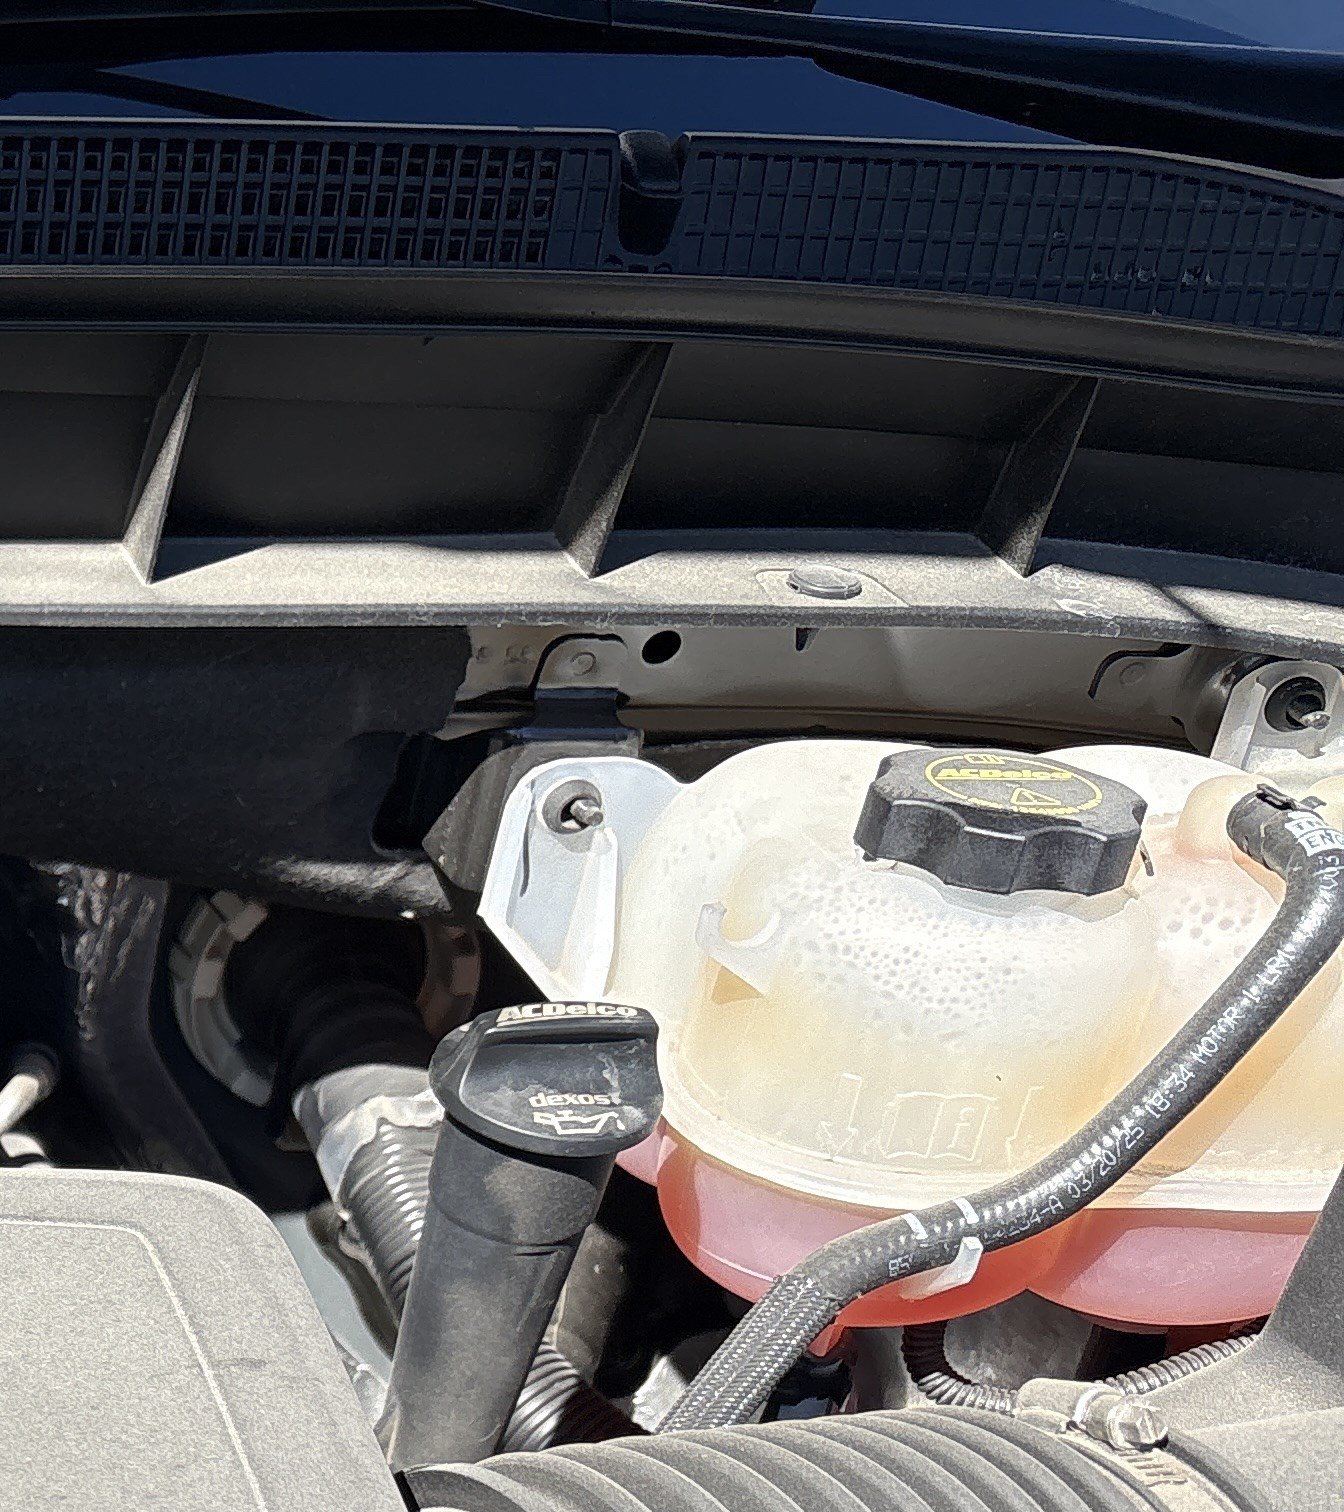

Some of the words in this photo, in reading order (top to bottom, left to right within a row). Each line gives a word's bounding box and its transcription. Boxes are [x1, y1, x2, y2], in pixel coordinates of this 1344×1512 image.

[496, 1002, 638, 1023] ACDelco
[529, 1093, 610, 1107] dexos
[1067, 1124, 1145, 1199] 03/20/25
[1145, 1062, 1196, 1119] 18:34
[1190, 1005, 1246, 1065] MOTOR
